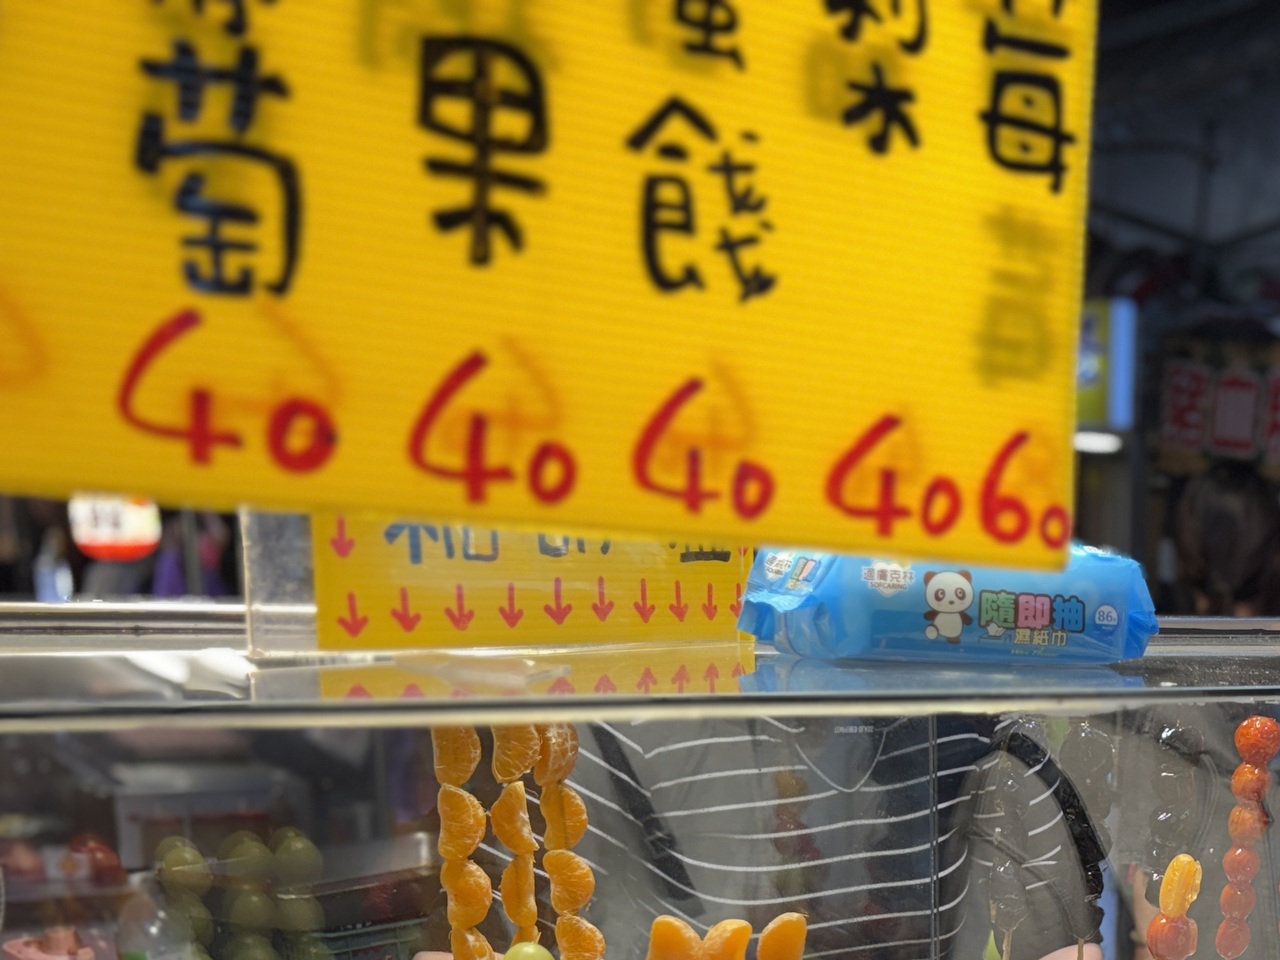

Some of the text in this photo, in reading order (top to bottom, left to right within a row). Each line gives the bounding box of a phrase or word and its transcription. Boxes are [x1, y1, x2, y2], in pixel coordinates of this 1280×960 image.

[136, 0, 304, 298] 萄
[118, 308, 1071, 550] 40 40 40 40 60
[979, 590, 1085, 632] 隨即抽
